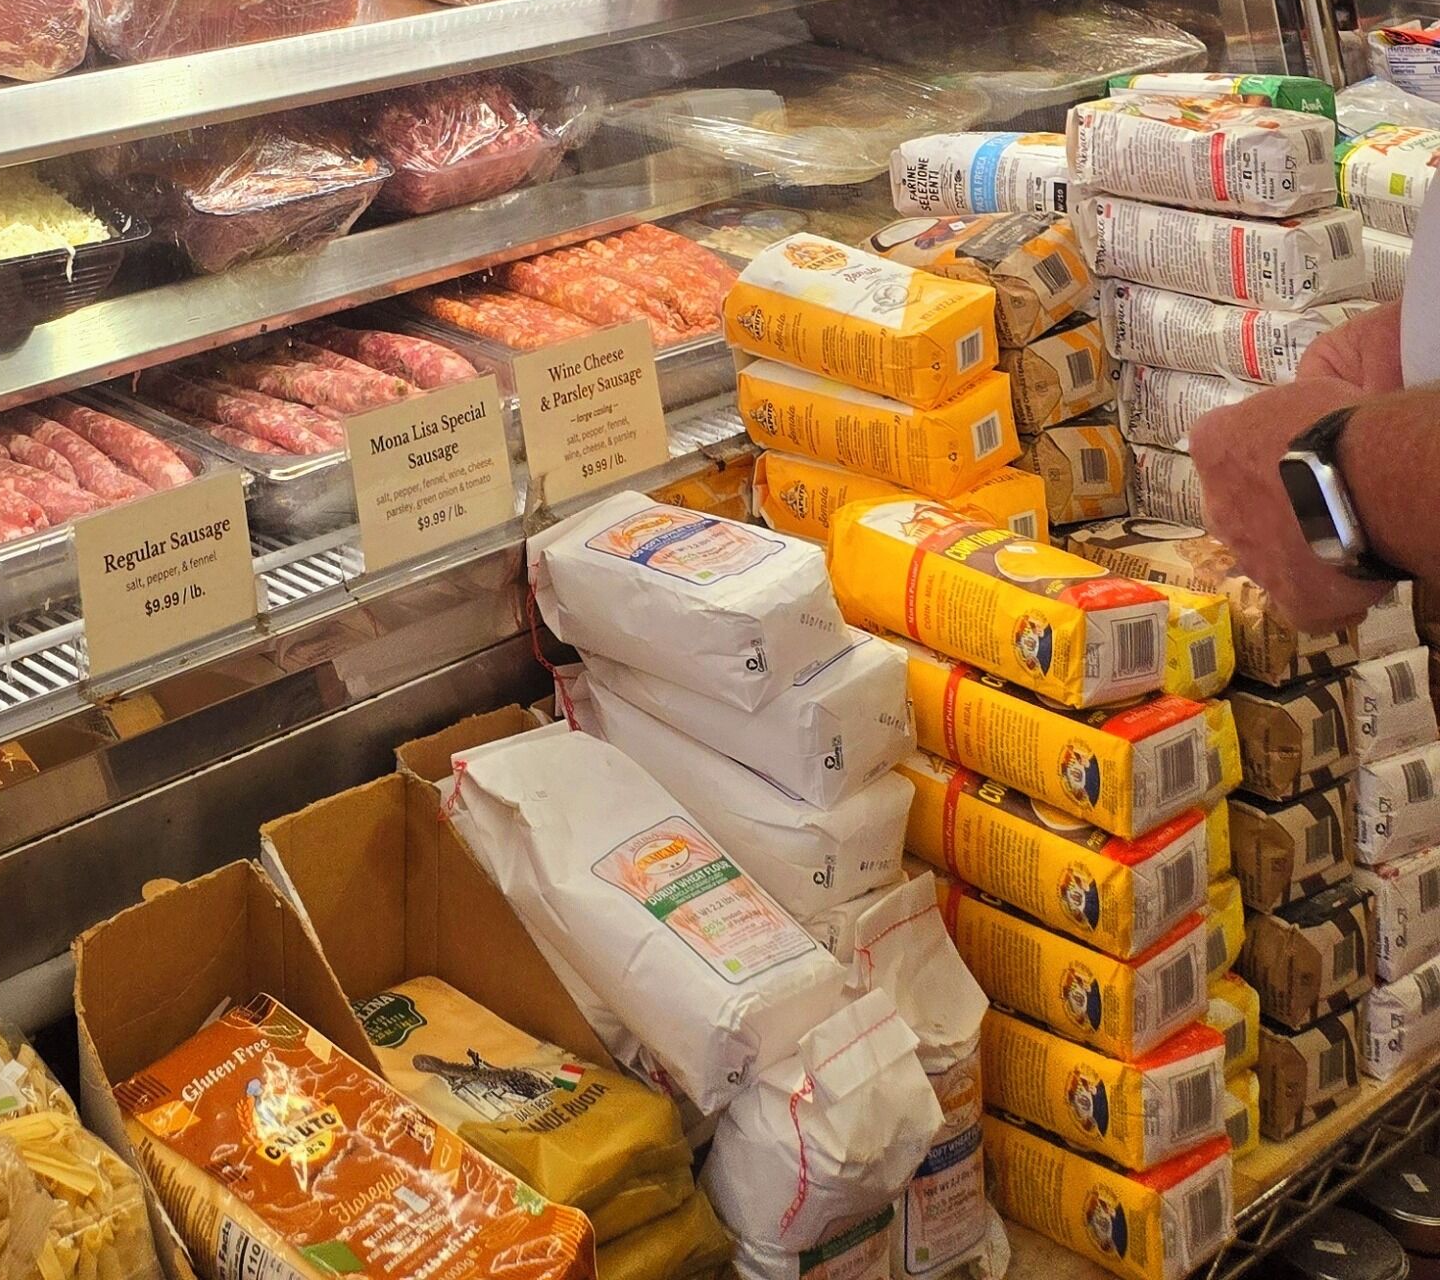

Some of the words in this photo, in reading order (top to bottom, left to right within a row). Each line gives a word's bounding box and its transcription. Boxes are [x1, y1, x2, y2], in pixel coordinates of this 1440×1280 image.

[906, 165, 917, 202] FARINE
[546, 359, 581, 384] Wine
[582, 345, 626, 375] Cheese
[369, 428, 409, 456] Mona
[411, 421, 439, 448] Lisa
[440, 401, 488, 438] Special
[407, 439, 460, 471] Sausage
[102, 538, 167, 575] Regular
[169, 514, 232, 553] Sausage
[143, 590, 181, 617] $9.99
[181, 586, 190, 607] /
[190, 582, 207, 604] lb.
[677, 869, 707, 890] WHEAT
[562, 1082, 611, 1119] RUOTA
